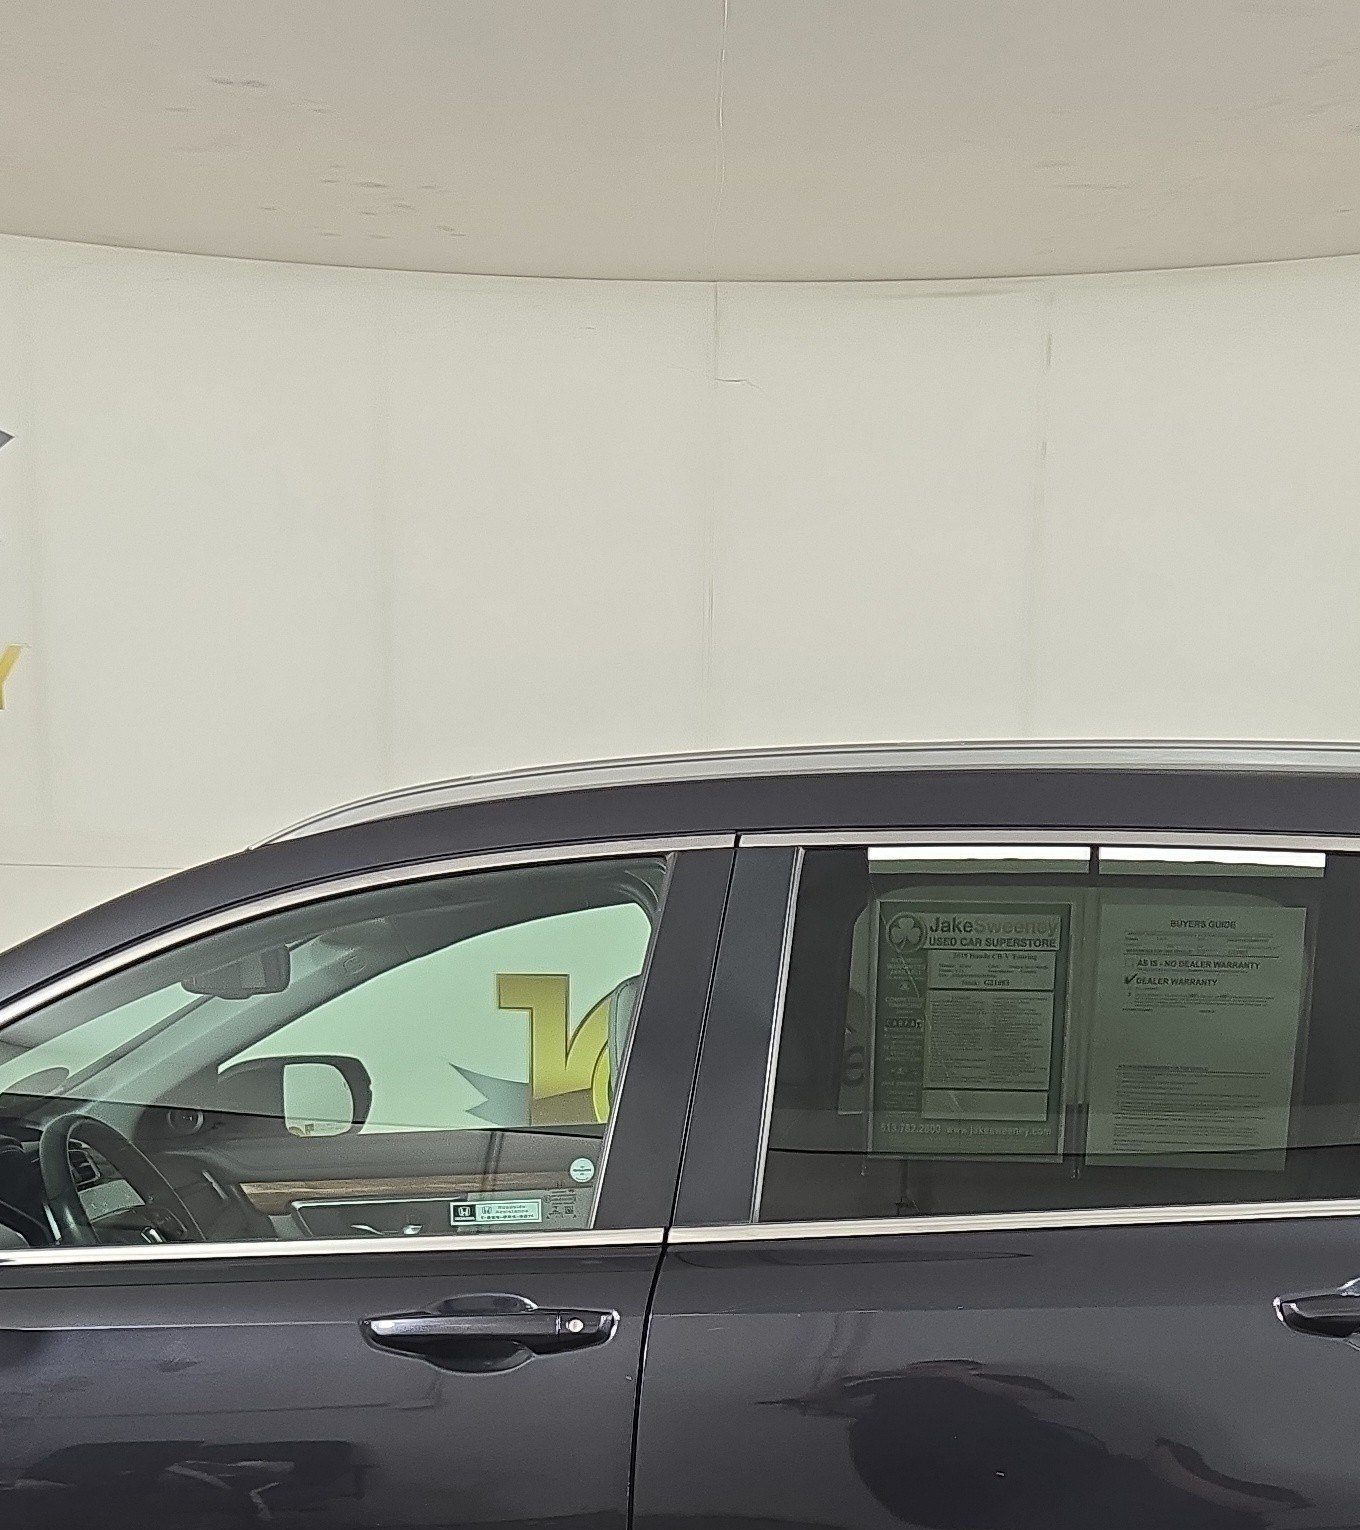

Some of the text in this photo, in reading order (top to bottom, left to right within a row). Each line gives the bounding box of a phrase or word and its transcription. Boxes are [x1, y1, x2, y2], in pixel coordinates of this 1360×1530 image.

[1170, 919, 1237, 929] BUYERS GUIDE
[929, 936, 1056, 948] USED CAR SUPERSTORE
[1178, 960, 1211, 969] DEALER
[1213, 961, 1261, 970] WARRANTY
[1136, 977, 1218, 986] DEALER WARRANTY
